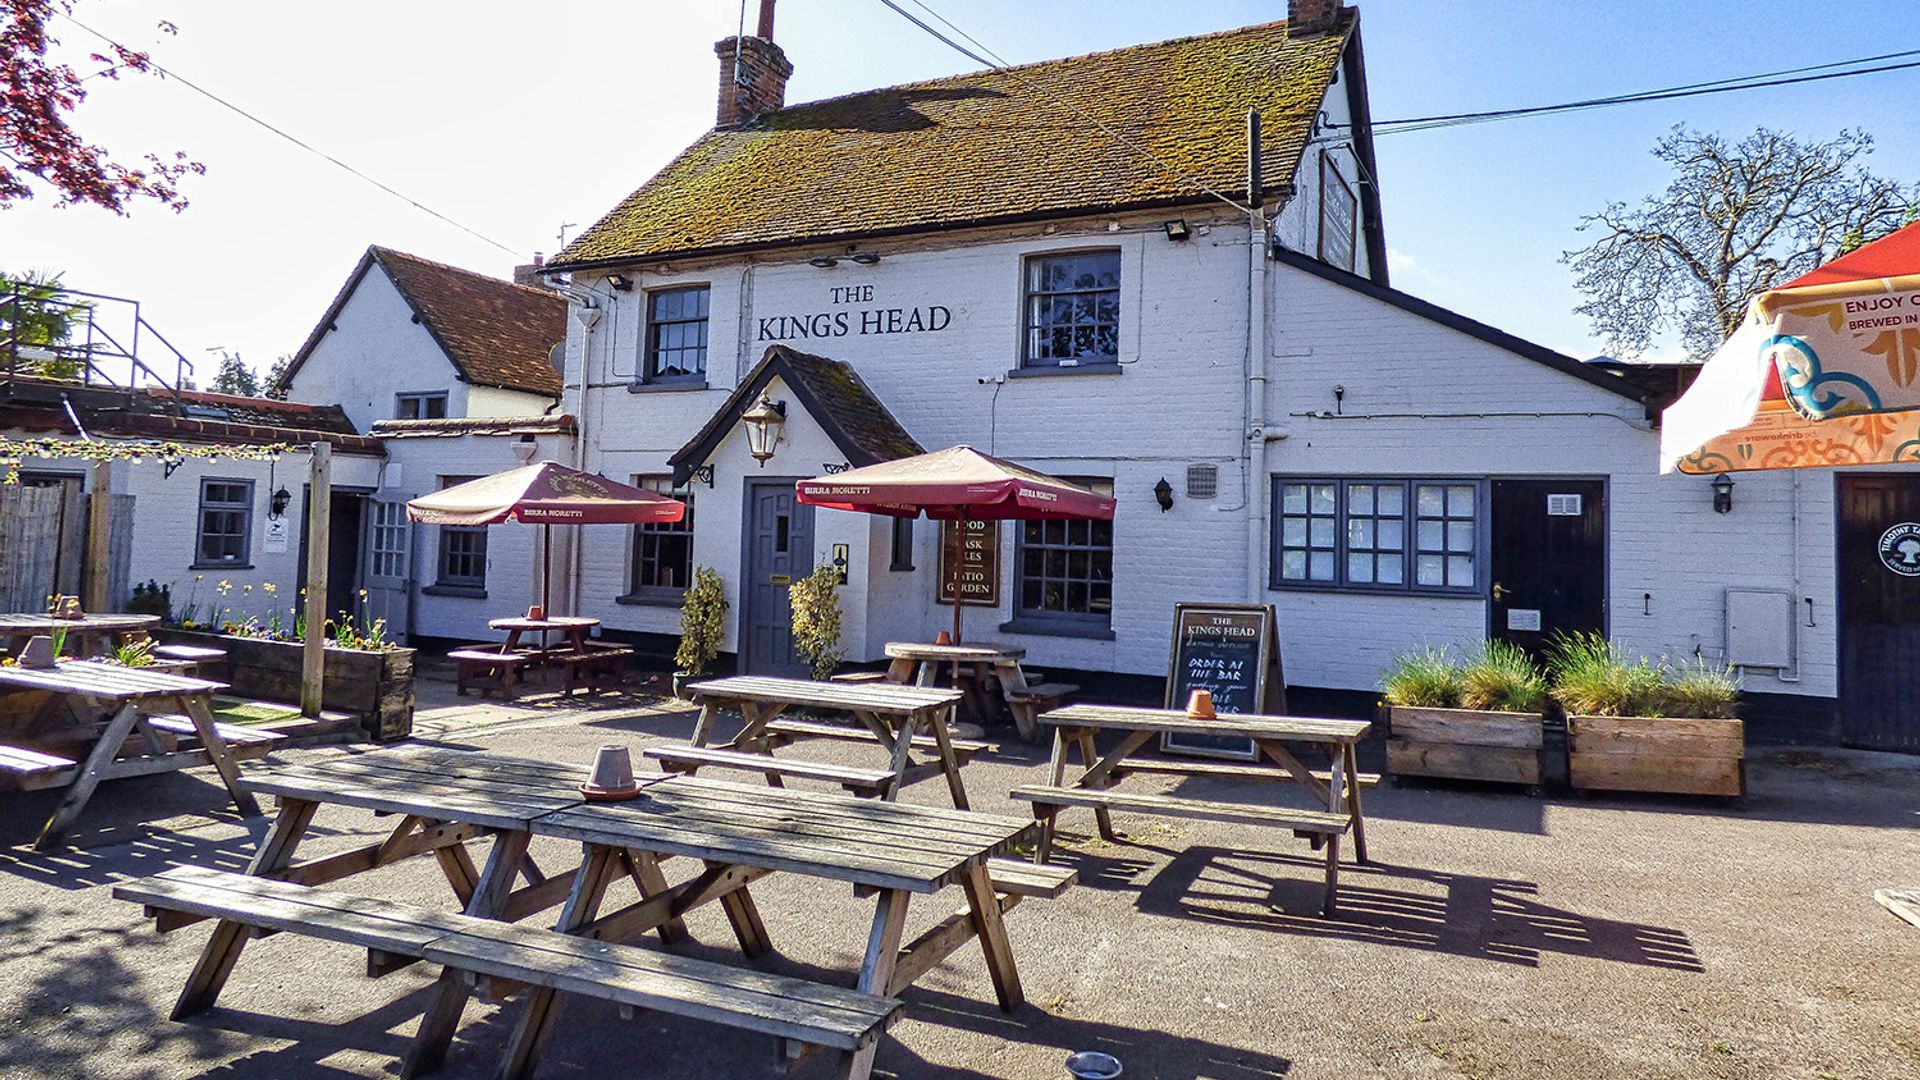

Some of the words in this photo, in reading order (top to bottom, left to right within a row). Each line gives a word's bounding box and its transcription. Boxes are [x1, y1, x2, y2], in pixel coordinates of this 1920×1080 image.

[829, 285, 875, 304] THE
[1846, 296, 1904, 313] ENJOY
[758, 311, 849, 341] KINGS
[859, 306, 951, 335] HEAD
[1849, 315, 1902, 330] BREWED
[1905, 314, 1919, 324] IN
[946, 583, 990, 593] GRDEN
[1212, 617, 1232, 625] THE
[1187, 625, 1221, 635] KINGS
[1223, 626, 1255, 636] HEAD
[1217, 670, 1241, 681] BAR
